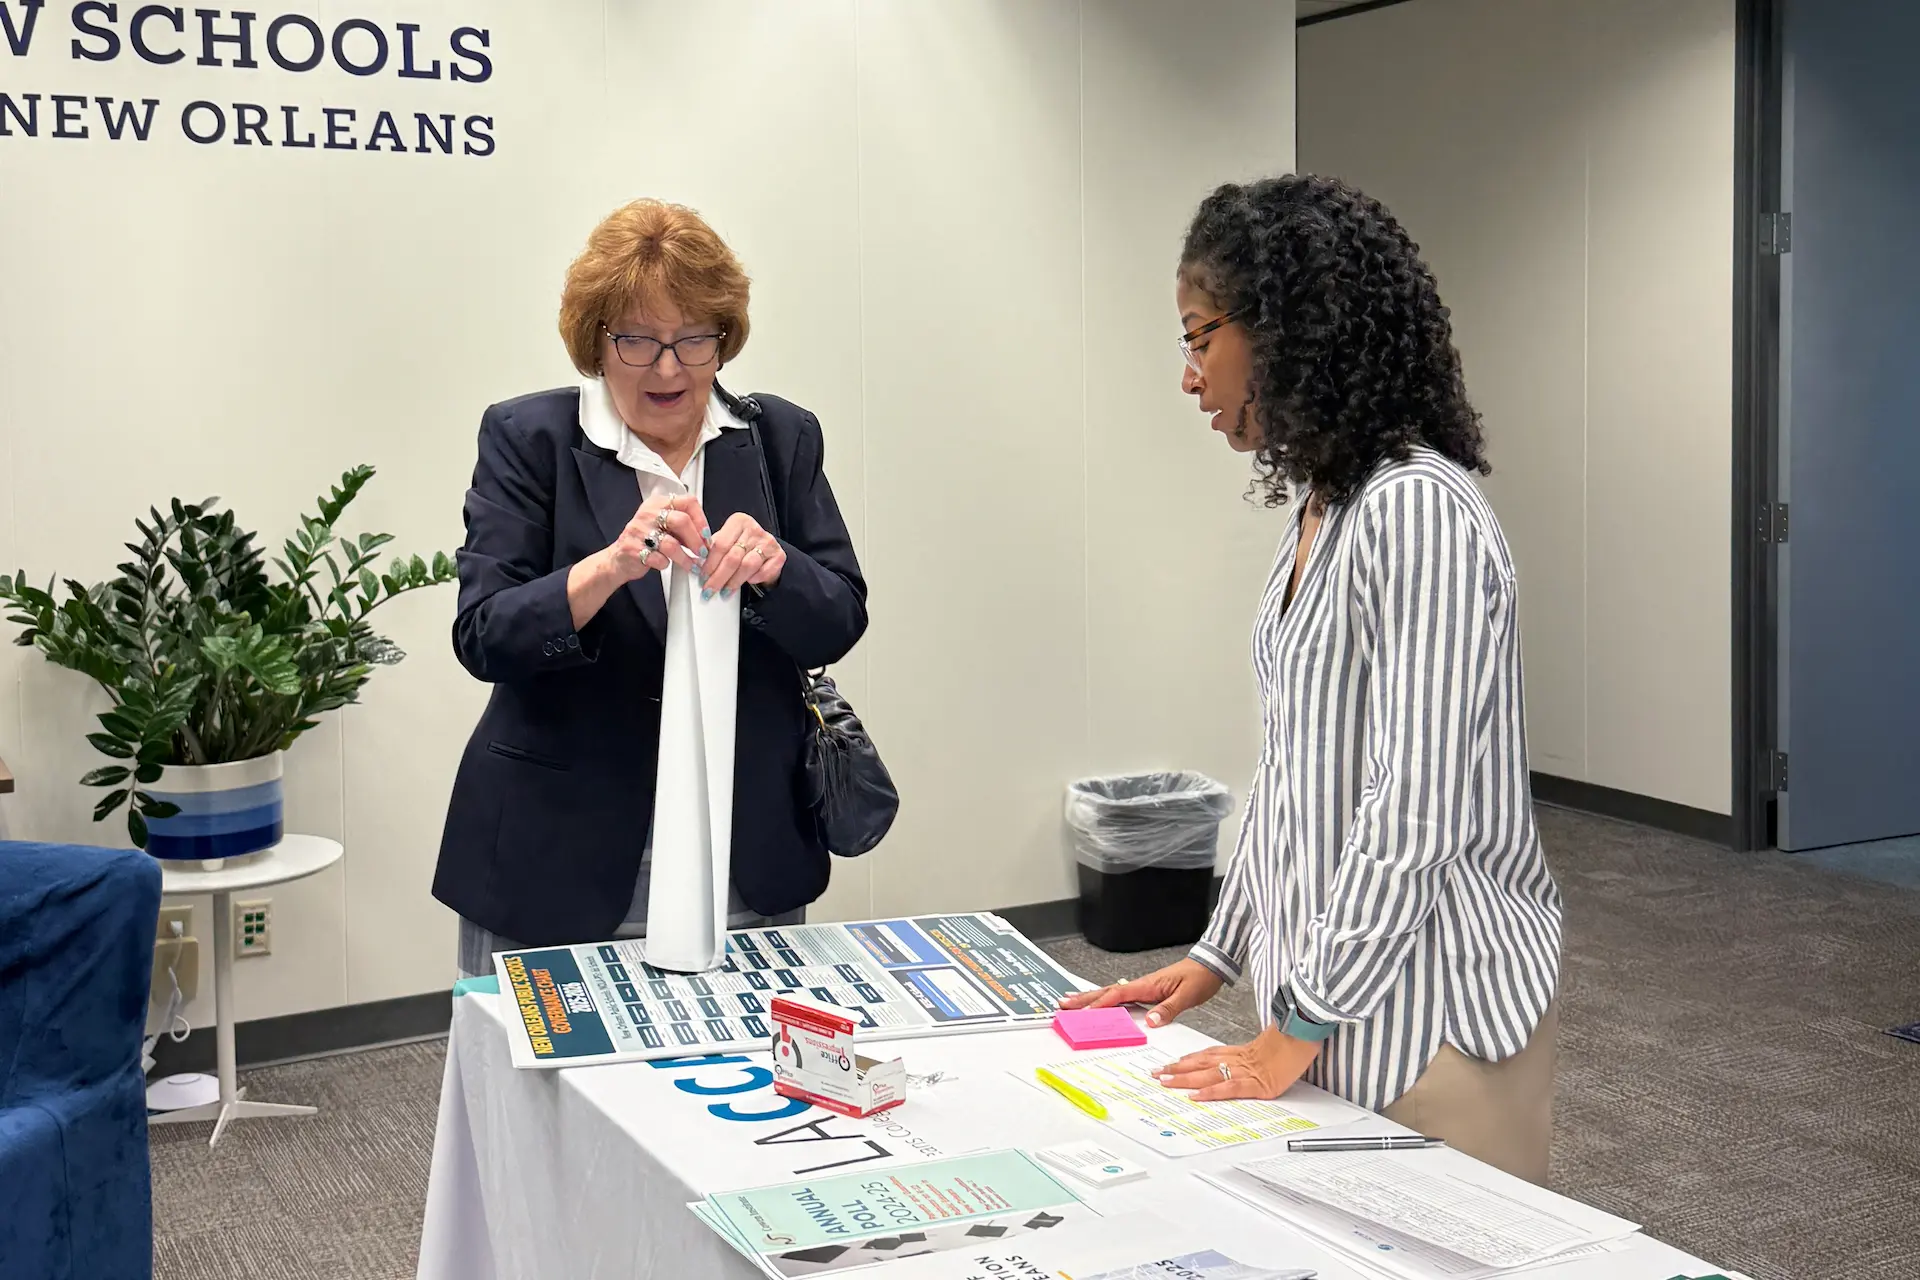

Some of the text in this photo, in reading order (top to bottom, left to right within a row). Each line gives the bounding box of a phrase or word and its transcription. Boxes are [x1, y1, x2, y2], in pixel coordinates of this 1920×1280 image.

[71, 1, 493, 83] SCHOOLS
[0, 92, 495, 156] NEW ORLEANS
[504, 956, 555, 1054] NEW ORLEANS PUBLIC SCHOOLS
[531, 968, 572, 1034] GOVERNANCE CHART
[820, 1050, 851, 1072] Office
[645, 1054, 894, 1174] LACC
[791, 1187, 850, 1234] ANNUAL
[842, 1199, 885, 1231] POLL
[860, 1180, 920, 1224] 2024-25
[974, 1256, 1020, 1280] TION
